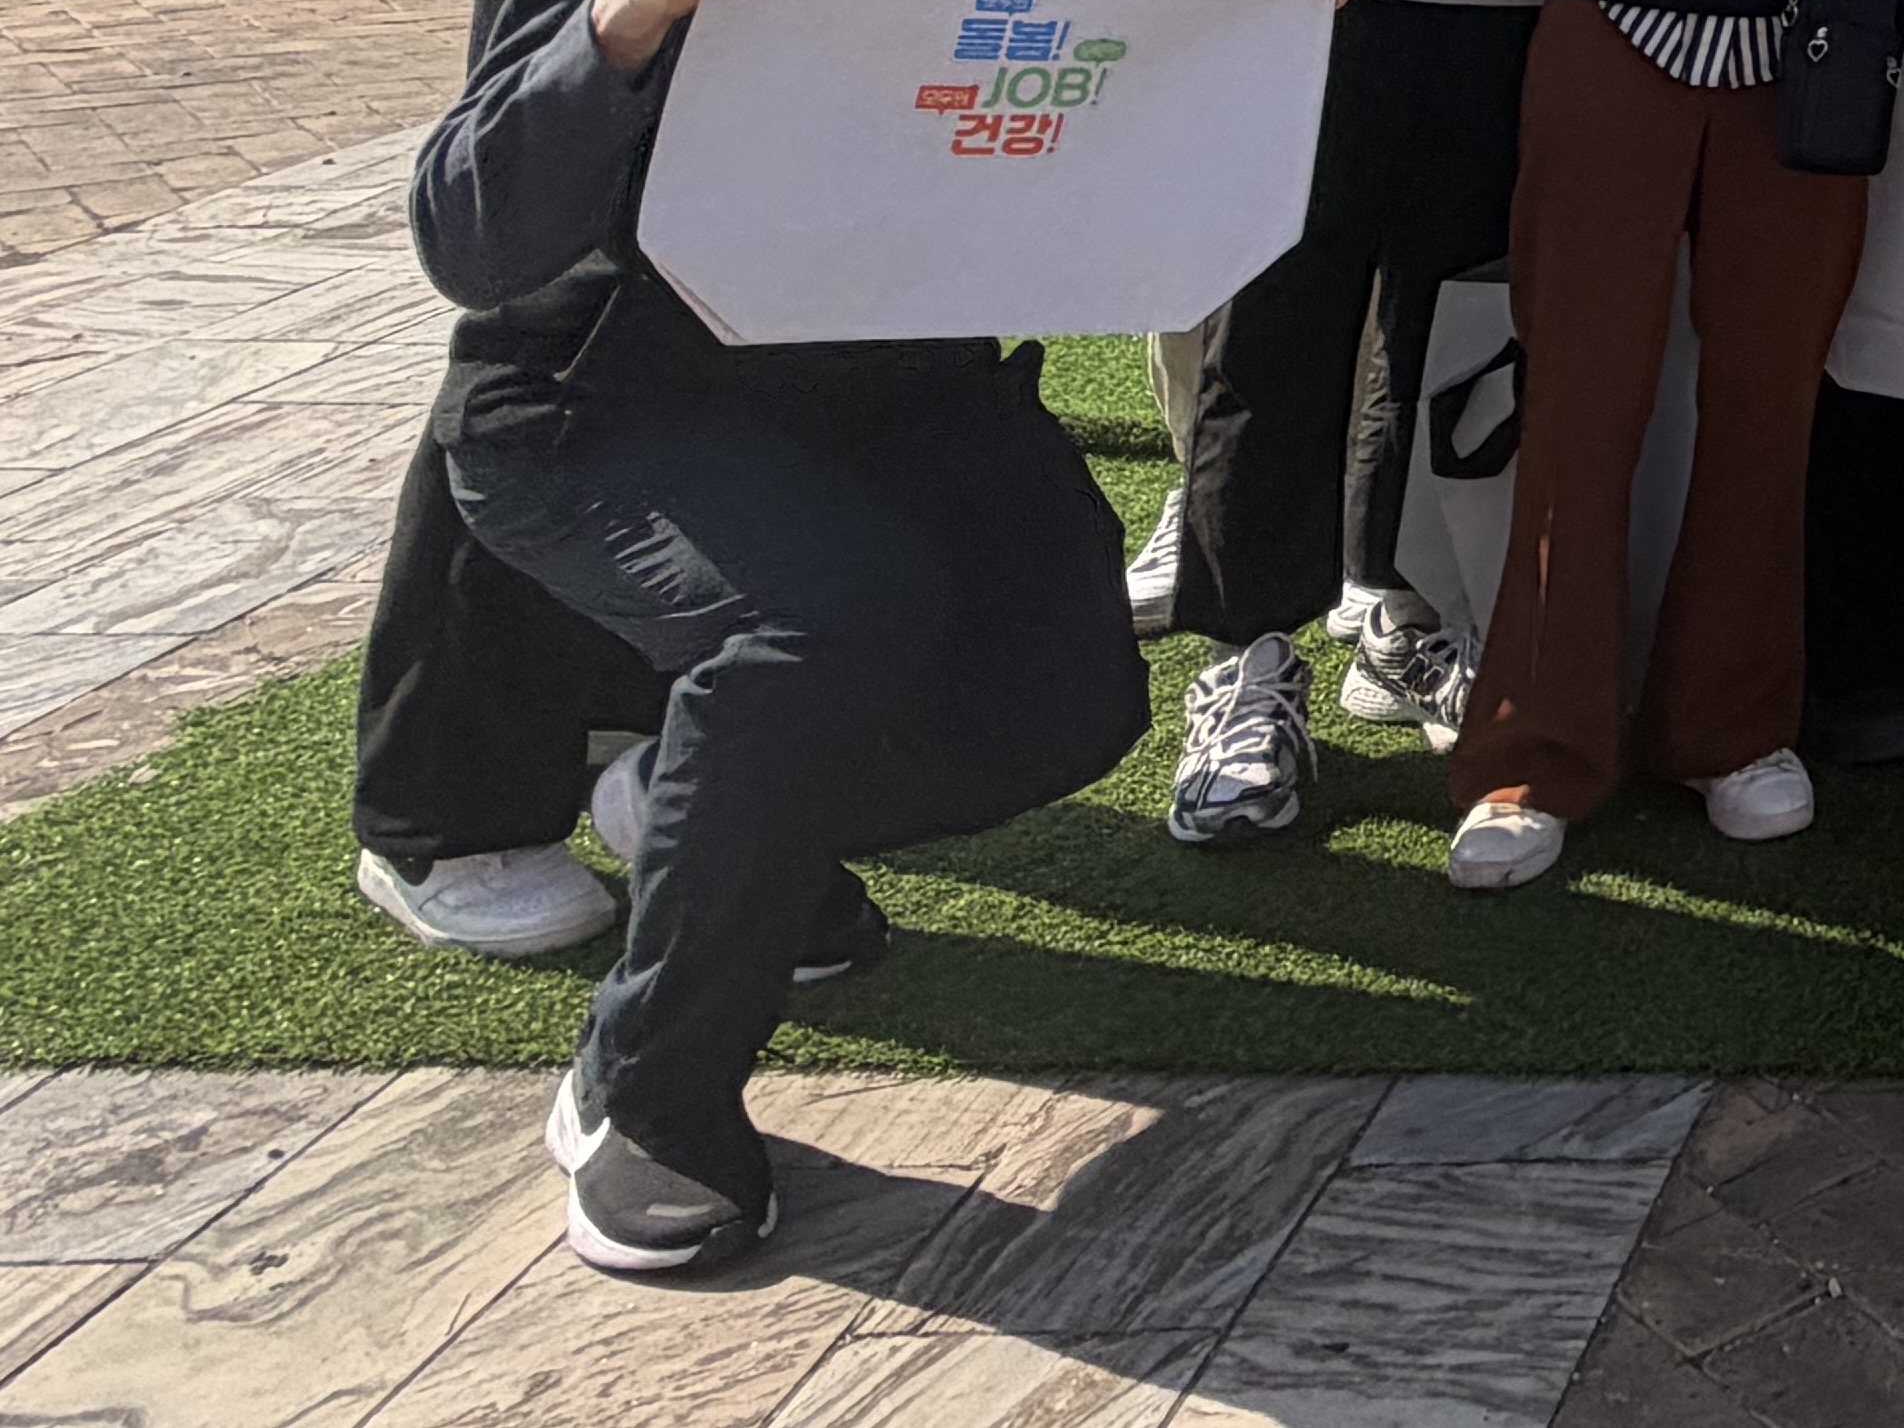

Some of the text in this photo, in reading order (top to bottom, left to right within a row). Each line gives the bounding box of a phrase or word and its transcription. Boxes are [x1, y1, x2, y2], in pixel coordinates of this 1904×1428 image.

[953, 18, 1072, 61] 돌봄!
[980, 66, 1108, 109] JOB!
[950, 112, 1065, 156] 건강!
